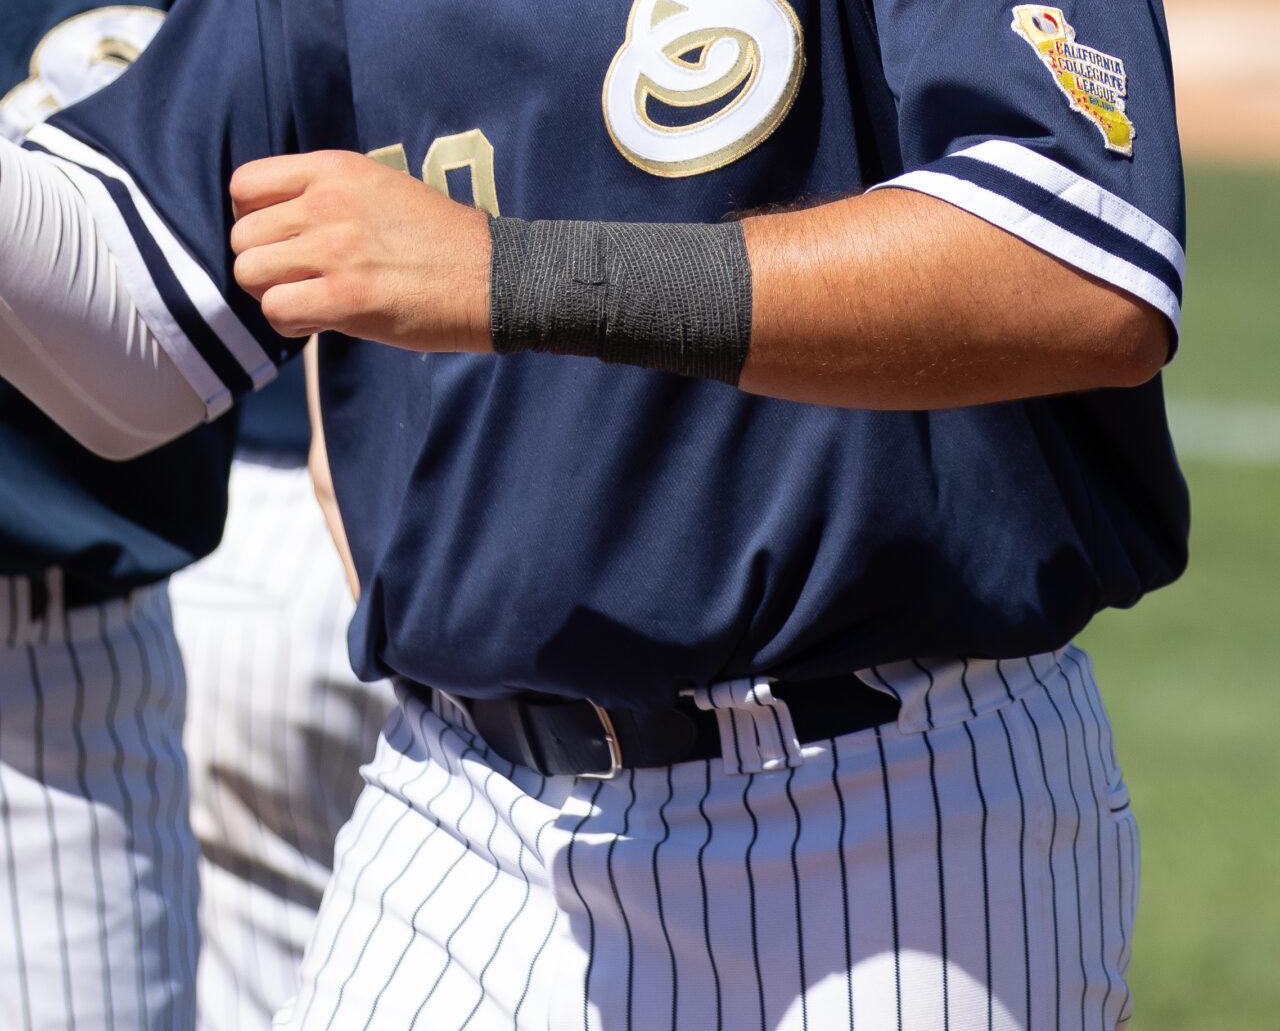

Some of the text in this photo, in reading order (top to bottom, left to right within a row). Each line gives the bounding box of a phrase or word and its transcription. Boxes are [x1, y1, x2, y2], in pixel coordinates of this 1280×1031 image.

[1056, 40, 1123, 76] CALIFORNIA
[1058, 58, 1124, 92] COLLEGIATE
[1076, 77, 1116, 104] LEAGUE
